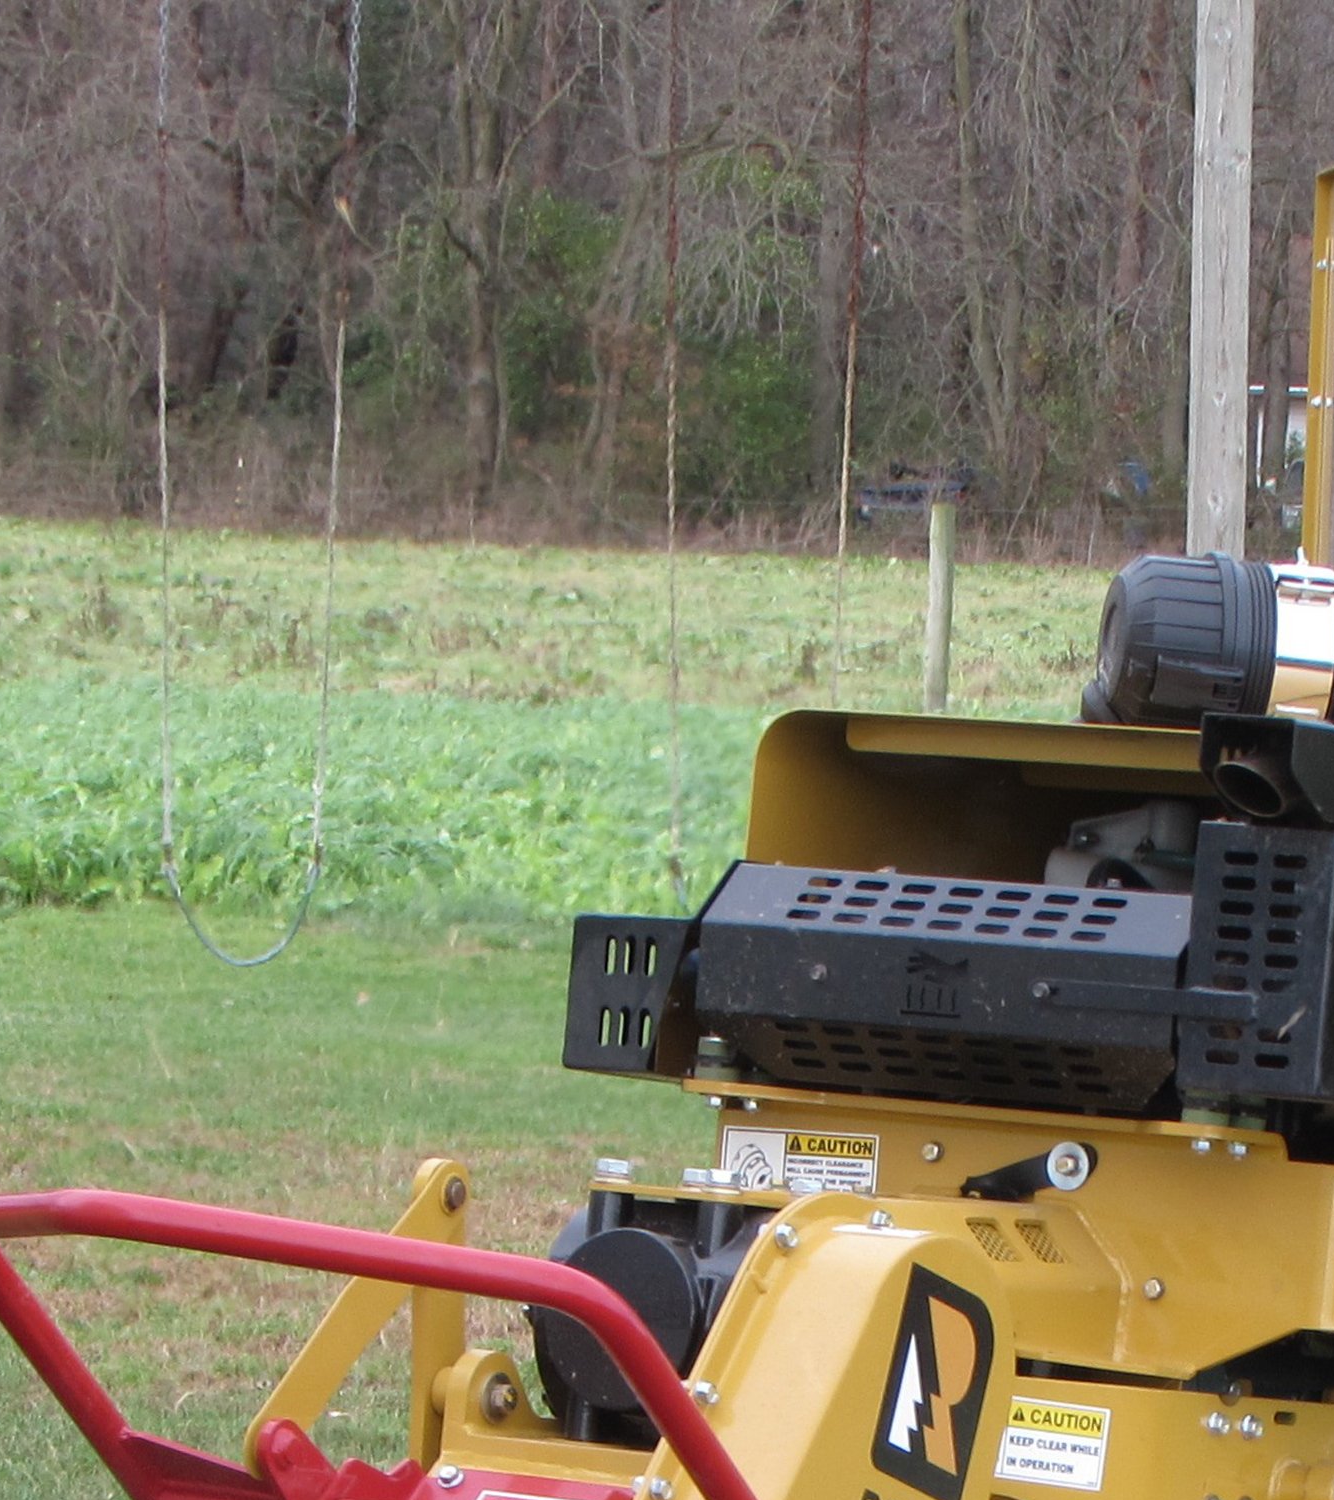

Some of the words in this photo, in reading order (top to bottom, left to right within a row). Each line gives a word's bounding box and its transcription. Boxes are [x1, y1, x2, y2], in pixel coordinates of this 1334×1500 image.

[807, 1138, 873, 1155] CAUTION
[1030, 1408, 1103, 1433] CAUTION
[1009, 1435, 1034, 1448] KEEP
[1036, 1439, 1067, 1451] CLEAR
[1070, 1443, 1100, 1456] WHILE
[1006, 1457, 1016, 1466] IN
[1019, 1459, 1074, 1474] OPERATION
